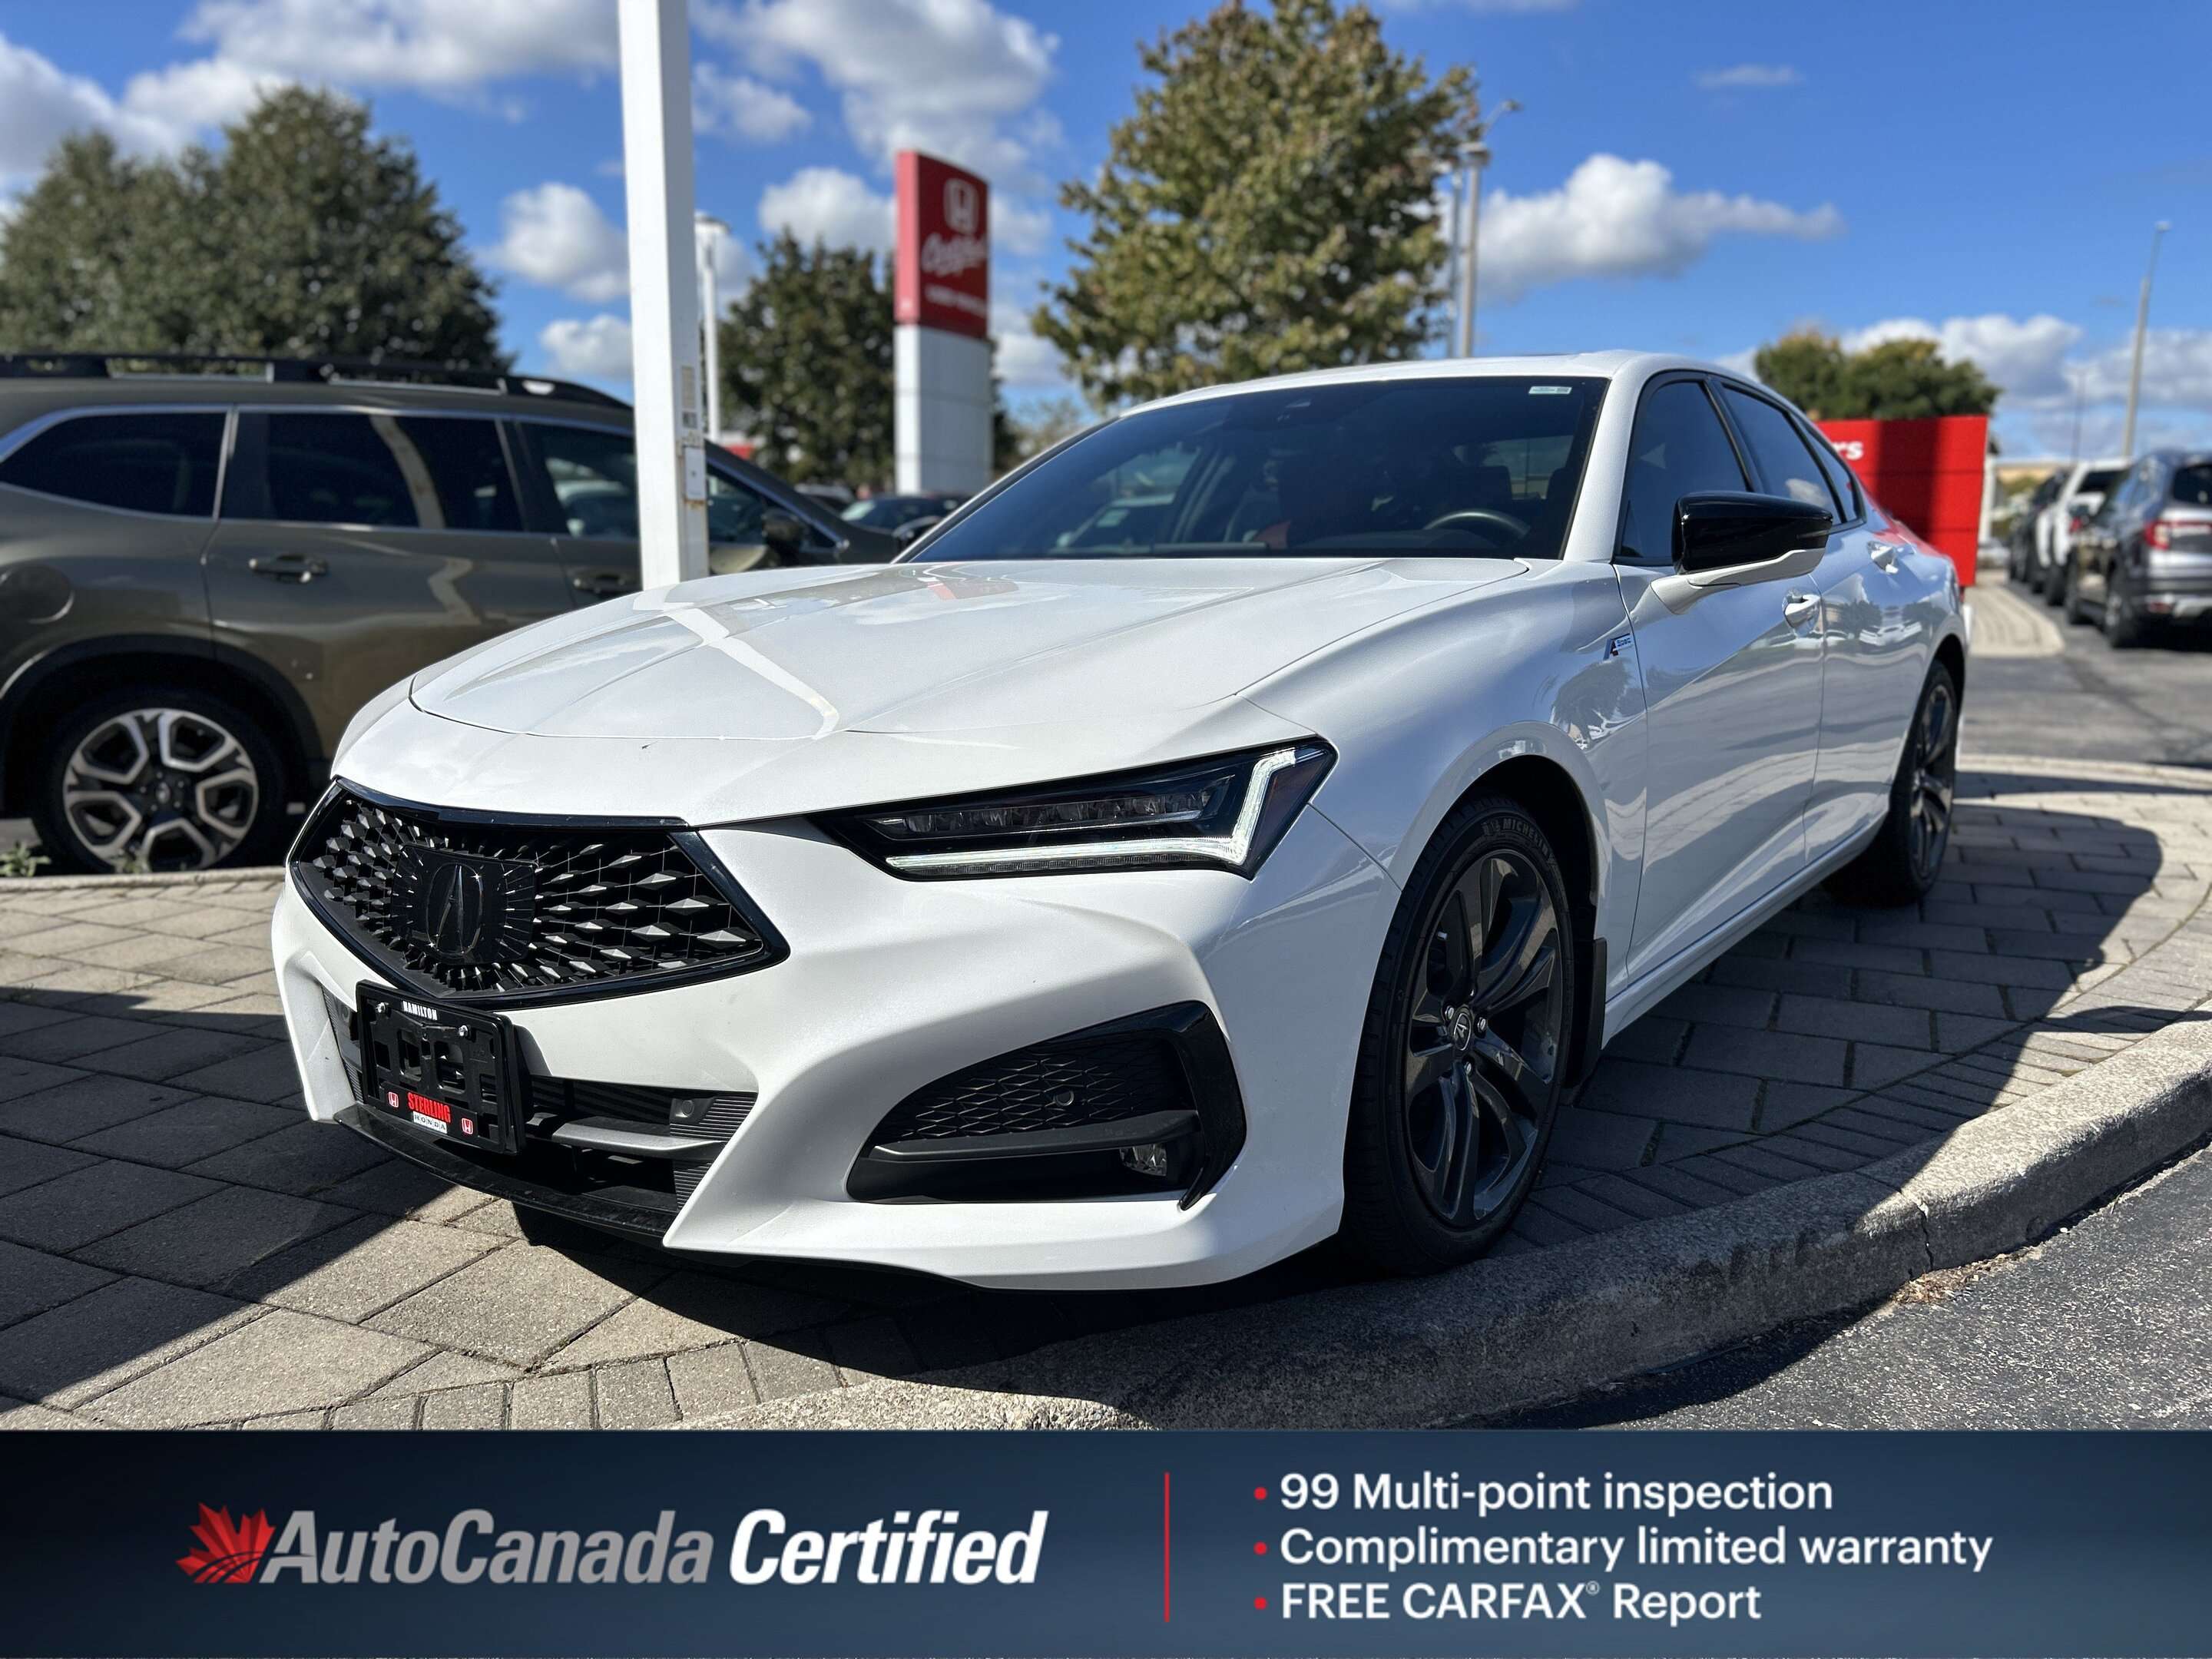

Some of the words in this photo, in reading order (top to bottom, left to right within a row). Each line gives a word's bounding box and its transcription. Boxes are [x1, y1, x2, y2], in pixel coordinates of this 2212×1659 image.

[1502, 818, 1549, 856] MICHELIN
[402, 1000, 438, 1021] HAMILTON
[407, 1091, 451, 1124] STERLING
[414, 1114, 446, 1131] HONDA
